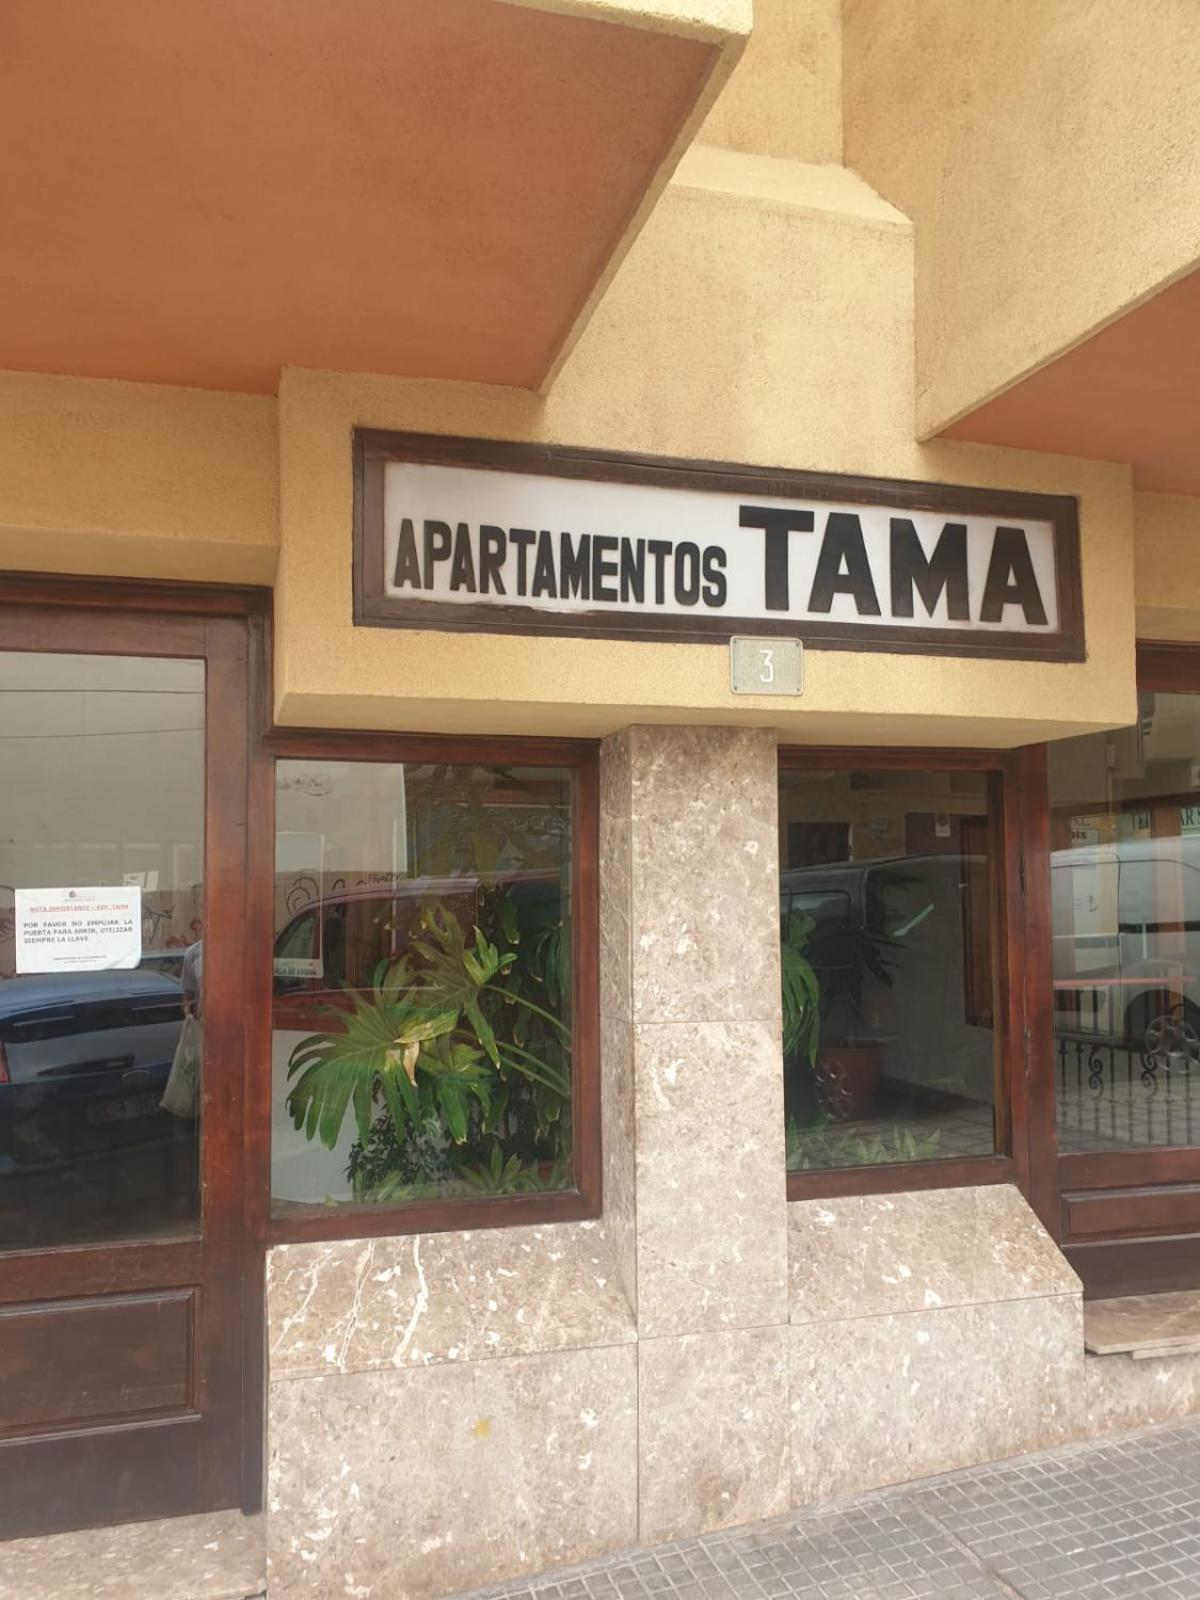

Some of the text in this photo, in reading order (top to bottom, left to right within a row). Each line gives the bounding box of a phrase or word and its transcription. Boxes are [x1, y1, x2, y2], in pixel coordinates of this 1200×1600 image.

[393, 504, 1049, 625] APARTAMENTOS TAMA
[760, 649, 775, 684] 3
